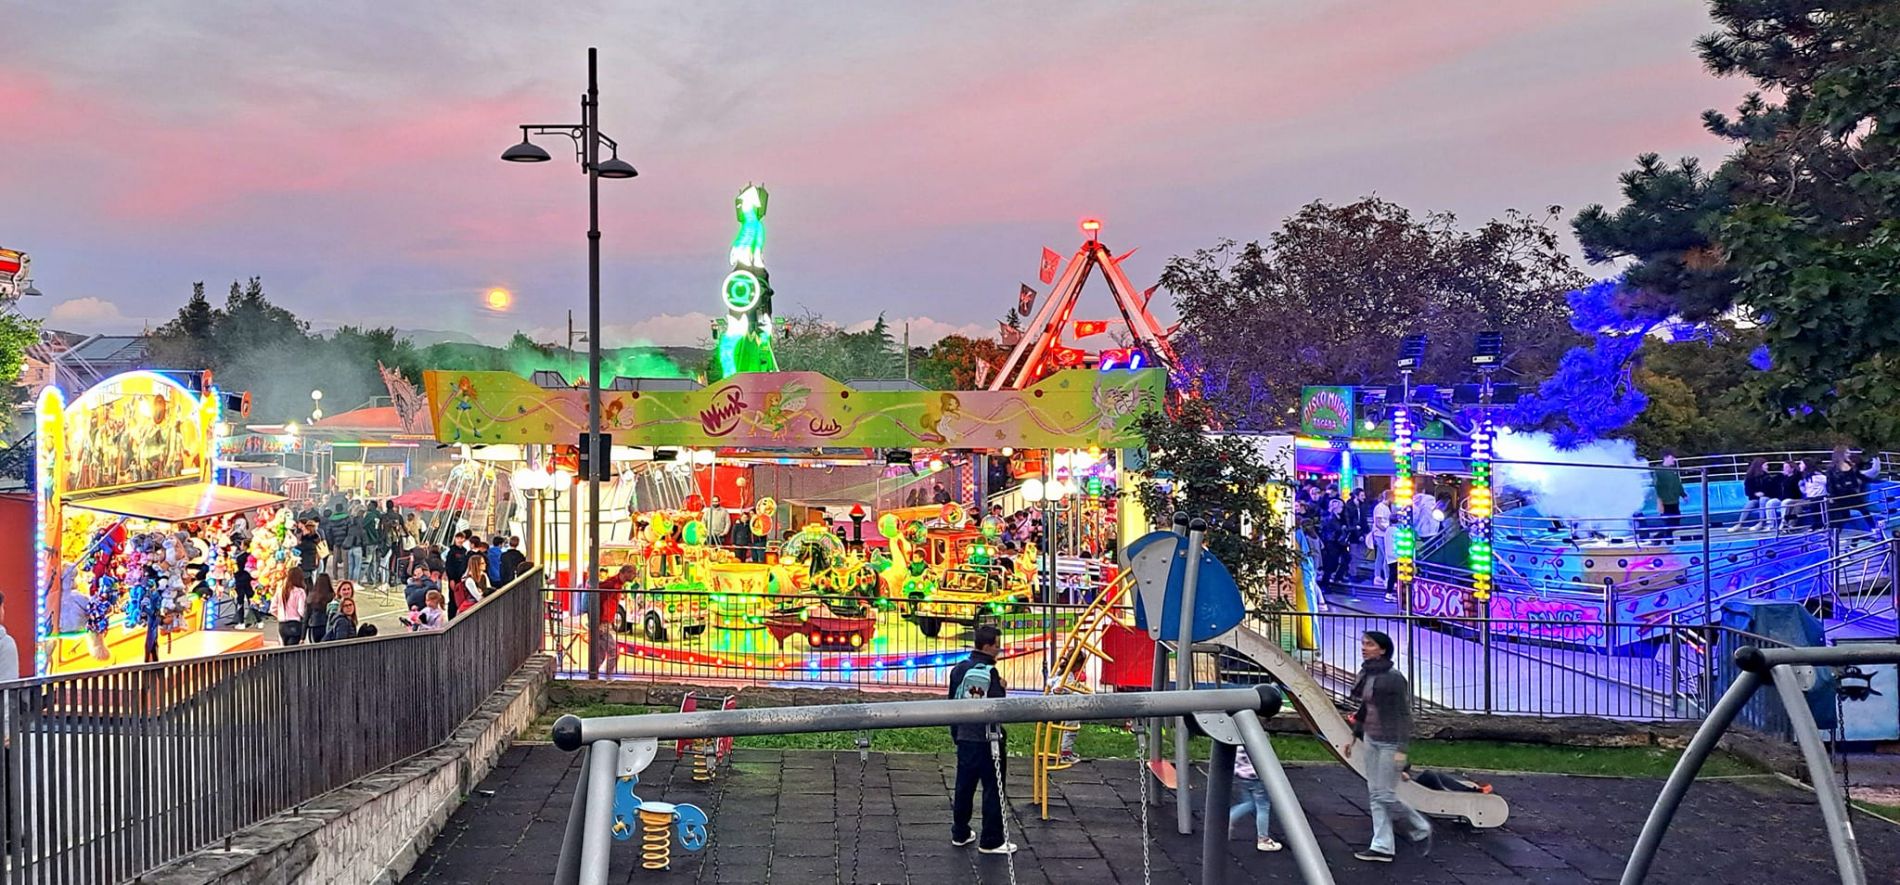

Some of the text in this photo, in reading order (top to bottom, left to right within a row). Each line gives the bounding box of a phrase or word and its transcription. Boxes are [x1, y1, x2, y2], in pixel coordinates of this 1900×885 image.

[1303, 391, 1350, 428] DISCO MUSIC
[809, 417, 842, 434] Club
